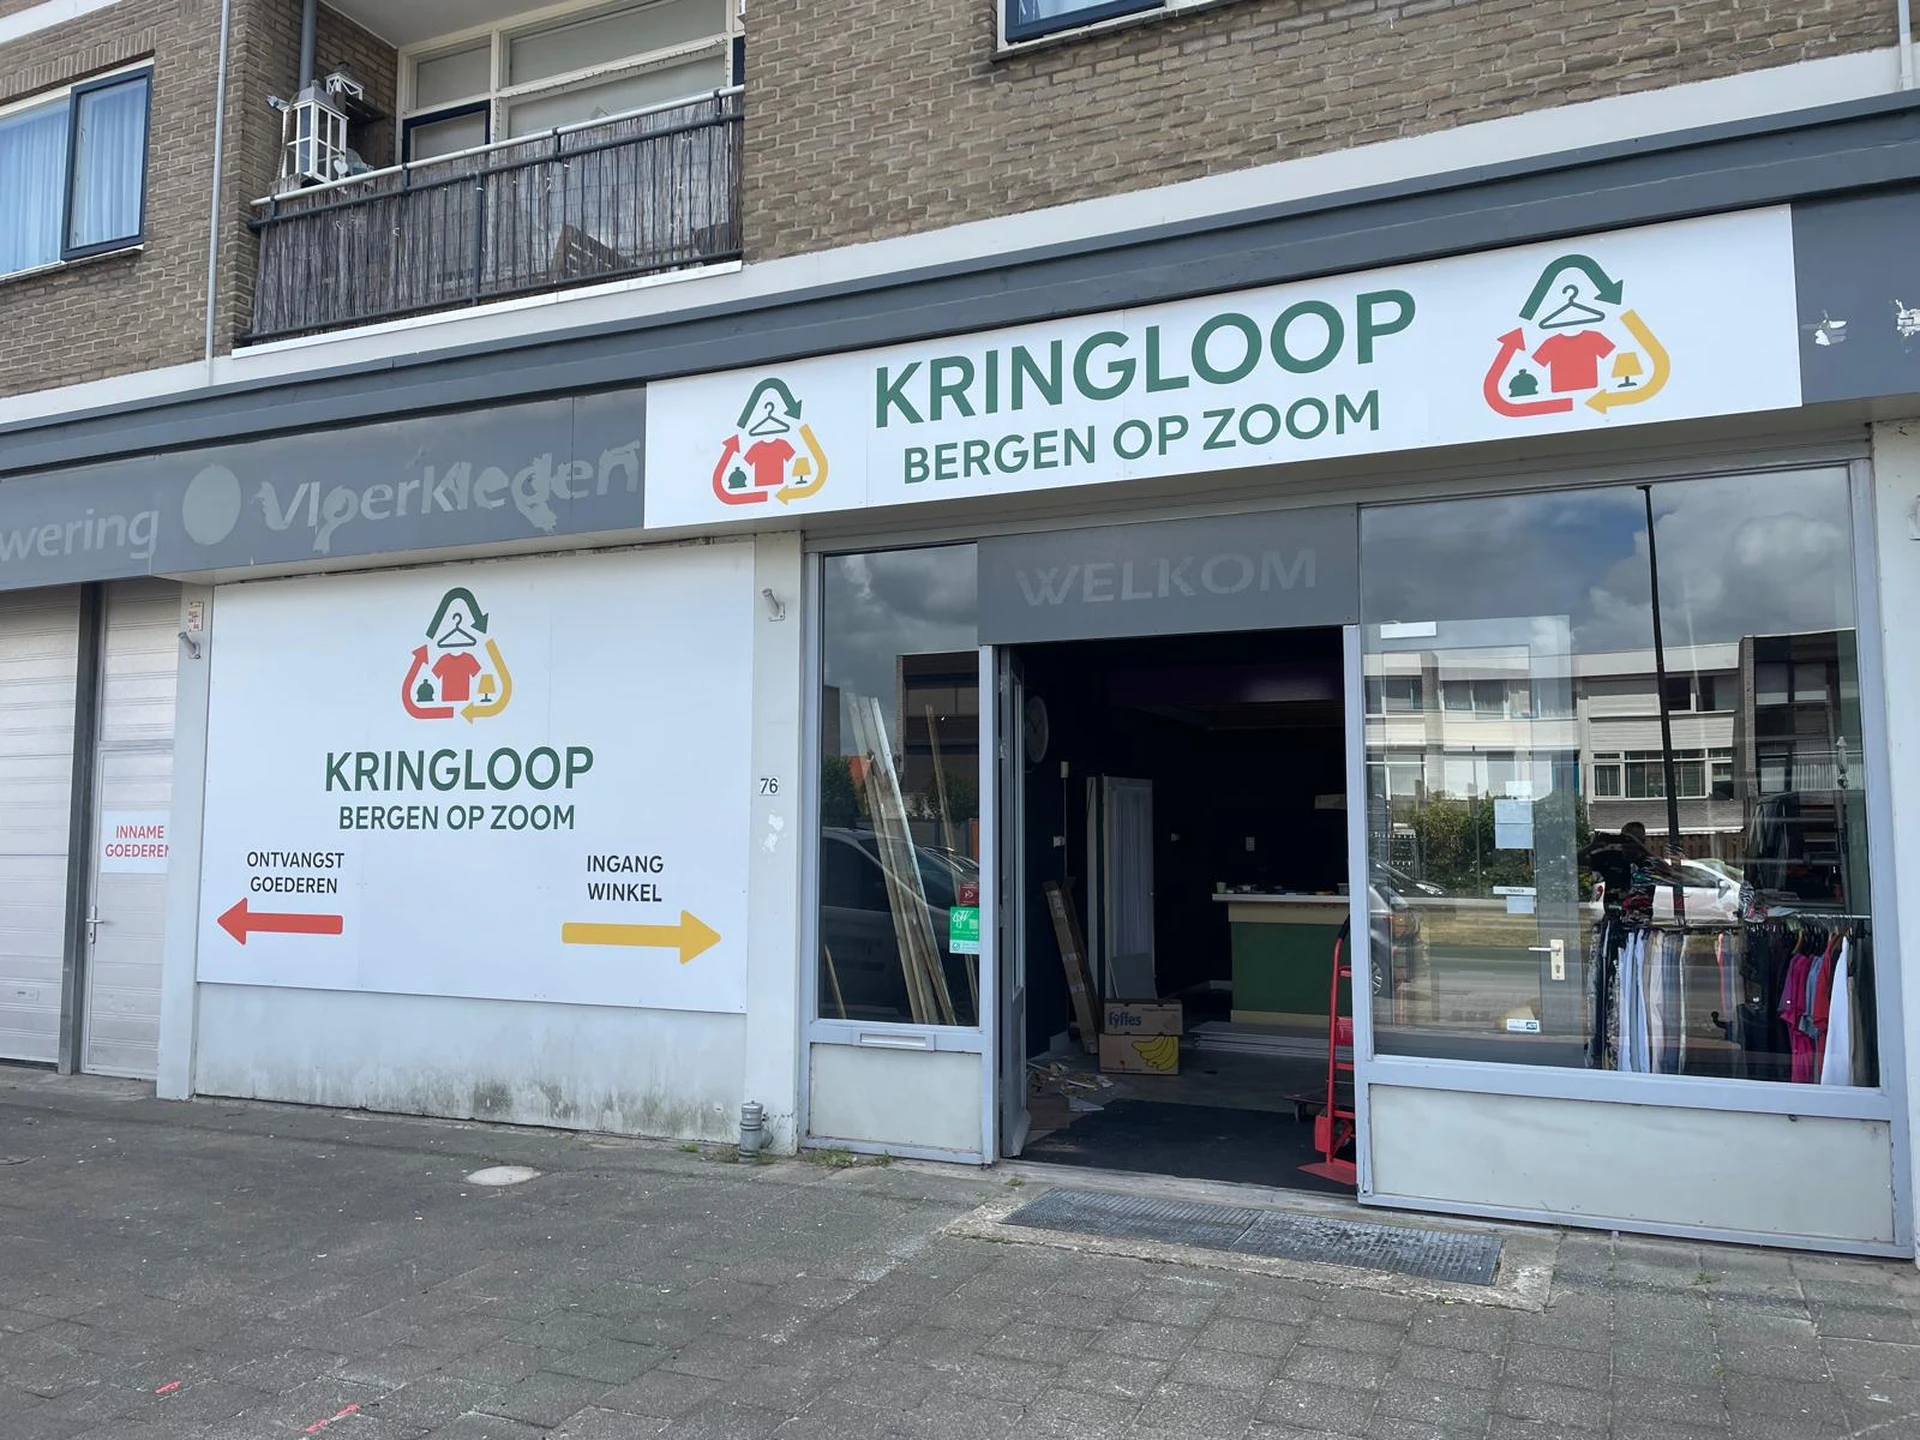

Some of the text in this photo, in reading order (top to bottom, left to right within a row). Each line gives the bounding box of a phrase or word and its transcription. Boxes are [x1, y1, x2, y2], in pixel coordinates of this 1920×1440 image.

[875, 289, 1417, 428] KRINGLOOP
[904, 389, 1380, 484] BERGEN OP ZOOM
[0, 508, 159, 562] wering
[1014, 547, 1318, 607] WELKOM
[324, 746, 595, 792] KRINGLOOP
[760, 777, 779, 794] 76
[338, 804, 576, 831] BERGEN OP ZOOM
[115, 825, 165, 839] INNAME
[246, 851, 345, 868] ONTVANGST
[586, 854, 664, 874] INGANG
[250, 876, 338, 893] GOEDEREN
[587, 882, 662, 902] WINKEL
